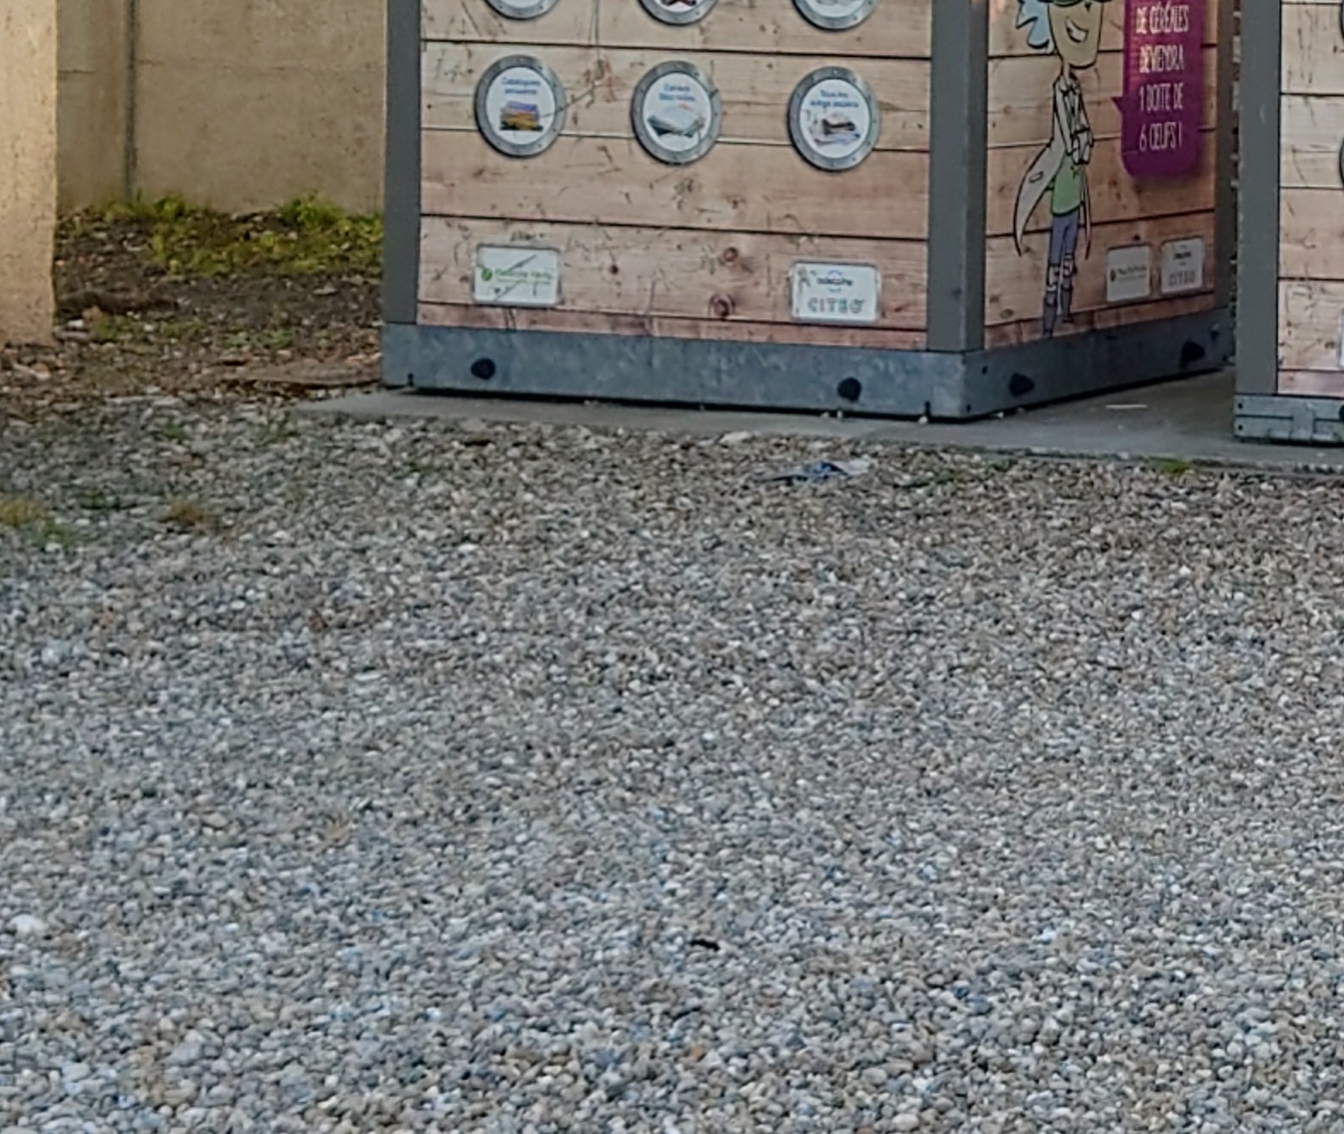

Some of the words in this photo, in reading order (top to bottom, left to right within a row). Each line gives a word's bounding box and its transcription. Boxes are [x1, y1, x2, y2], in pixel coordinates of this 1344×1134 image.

[1135, 5, 1148, 34] DE
[1139, 85, 1145, 113] 1
[1173, 81, 1184, 111] DE
[1139, 122, 1147, 153] 6
